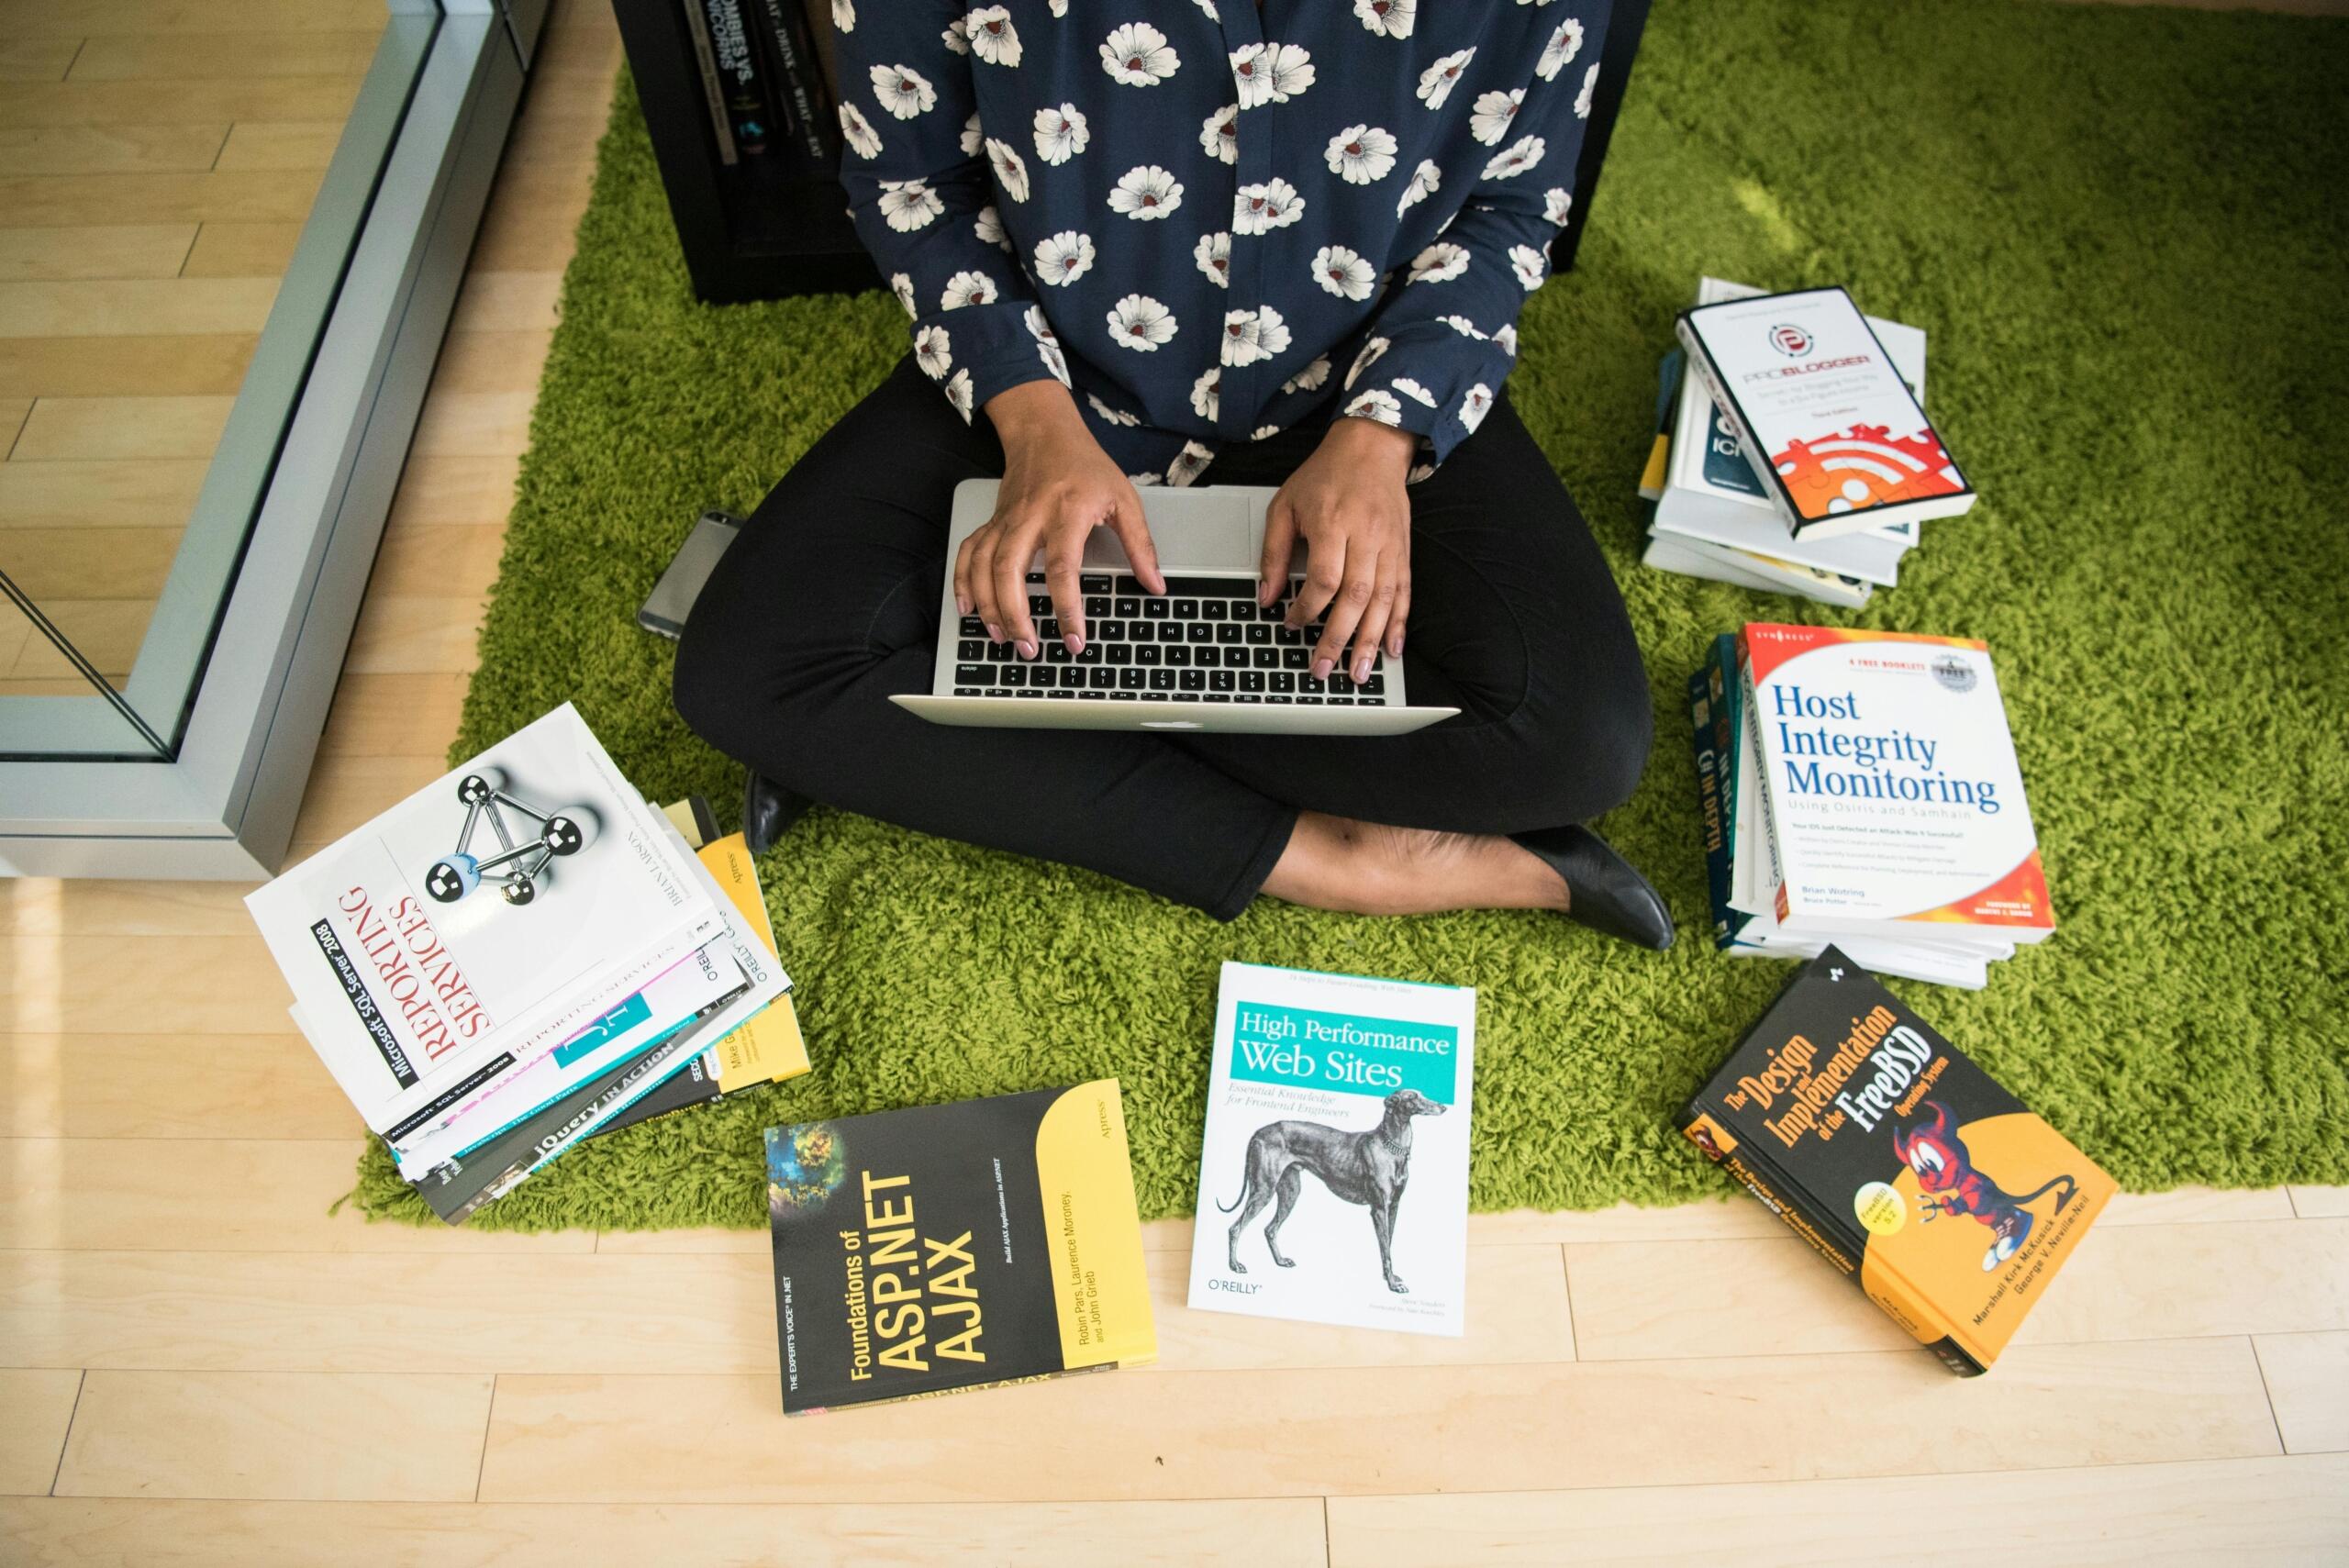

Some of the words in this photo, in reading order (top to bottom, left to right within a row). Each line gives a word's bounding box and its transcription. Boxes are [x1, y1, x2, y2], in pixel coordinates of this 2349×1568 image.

[775, 28, 796, 69] DRINK
[794, 86, 812, 122] WHAT
[807, 137, 823, 159] EAT
[1772, 684, 1861, 719] Host
[1777, 721, 1937, 771] Integrity
[1702, 773, 1715, 795] IN
[1749, 708, 1765, 781] INTEGRITY
[1760, 783, 1780, 887] MONITORING
[1784, 760, 2000, 815] Monitoring
[1704, 796, 1721, 852] DEPTH
[1787, 799, 1829, 814] Using
[1833, 801, 1875, 815] Osiris
[1881, 805, 1905, 817] and
[1910, 806, 1972, 820] Samhain
[629, 830, 660, 873] LARSON
[656, 872, 684, 906] BRIAN
[1802, 885, 1825, 895] Brian
[1828, 887, 1865, 897] Wotring
[316, 924, 340, 955] 2008
[334, 955, 361, 994] Server
[339, 885, 458, 1062] REPORTING
[388, 895, 491, 1039] SERVICES
[695, 949, 718, 981] O'REIL
[354, 992, 376, 1018] SQL
[367, 1016, 412, 1078] Microsoft
[1240, 1012, 1297, 1041] High
[1304, 1019, 1450, 1055] Performance
[729, 1046, 742, 1069] Mike
[1239, 1040, 1316, 1077] Web
[1325, 1051, 1403, 1088] Sites
[1724, 1090, 1749, 1111] The
[1737, 1034, 1818, 1110] Design
[1228, 1083, 1275, 1097] Essential
[1277, 1087, 1337, 1106] Knowledge
[1764, 1006, 1898, 1148] Implementation
[1796, 1071, 1813, 1092] and
[1835, 1025, 1932, 1133] FreeBSD
[1894, 1078, 1932, 1118] Operating
[1920, 1056, 1950, 1083] System
[391, 1106, 435, 1138] Microsoft
[436, 1094, 456, 1108] SQL
[455, 1072, 486, 1097] Server
[487, 1056, 510, 1073] 2008
[529, 1099, 554, 1116] Good
[556, 1084, 579, 1100] Parts
[534, 1101, 601, 1158] jQuery
[602, 1086, 621, 1101] IN
[622, 1041, 674, 1088] ACTION
[1225, 1094, 1241, 1106] for
[1241, 1095, 1295, 1112] Frontend
[1297, 1104, 1351, 1118] Engineers
[1100, 1100, 1111, 1139] Apress
[1818, 1118, 1834, 1141] of
[1825, 1109, 1846, 1130] the
[998, 1192, 1009, 1229] Applications
[1731, 1157, 1746, 1173] The
[1745, 1172, 1774, 1198] Design
[1773, 1198, 1792, 1213] and
[1789, 1212, 1854, 1272] Implementation
[1746, 1184, 1781, 1214] FreeBSD
[1861, 1188, 1887, 1219] FreeBSD
[1873, 1198, 1894, 1224] version
[1884, 1210, 1897, 1224] 5.2
[839, 1230, 861, 1251] of
[1002, 1229, 1010, 1246] AJAX
[1004, 1246, 1012, 1263] Build
[2014, 1259, 2045, 1296] George
[2041, 1246, 2052, 1259] V.
[2048, 1195, 2090, 1250] Neville-Neil
[862, 1170, 930, 1372] ASP.NET
[1067, 1239, 1082, 1286] Laurence
[1973, 1283, 2007, 1327] Marshall
[2005, 1262, 2023, 1284] Kirk
[2020, 1219, 2055, 1262] McKusick
[785, 1294, 792, 1304] IN
[924, 1230, 986, 1362] AJAX
[1085, 1271, 1098, 1299] Grieb
[844, 1254, 873, 1381] Foundations
[1079, 1311, 1089, 1346] Robin
[1090, 1302, 1102, 1325] John
[1097, 1328, 1105, 1343] and
[787, 1334, 797, 1373] EXPERT'S
[790, 1373, 798, 1391] THE
[997, 1373, 1052, 1387] AJAX
